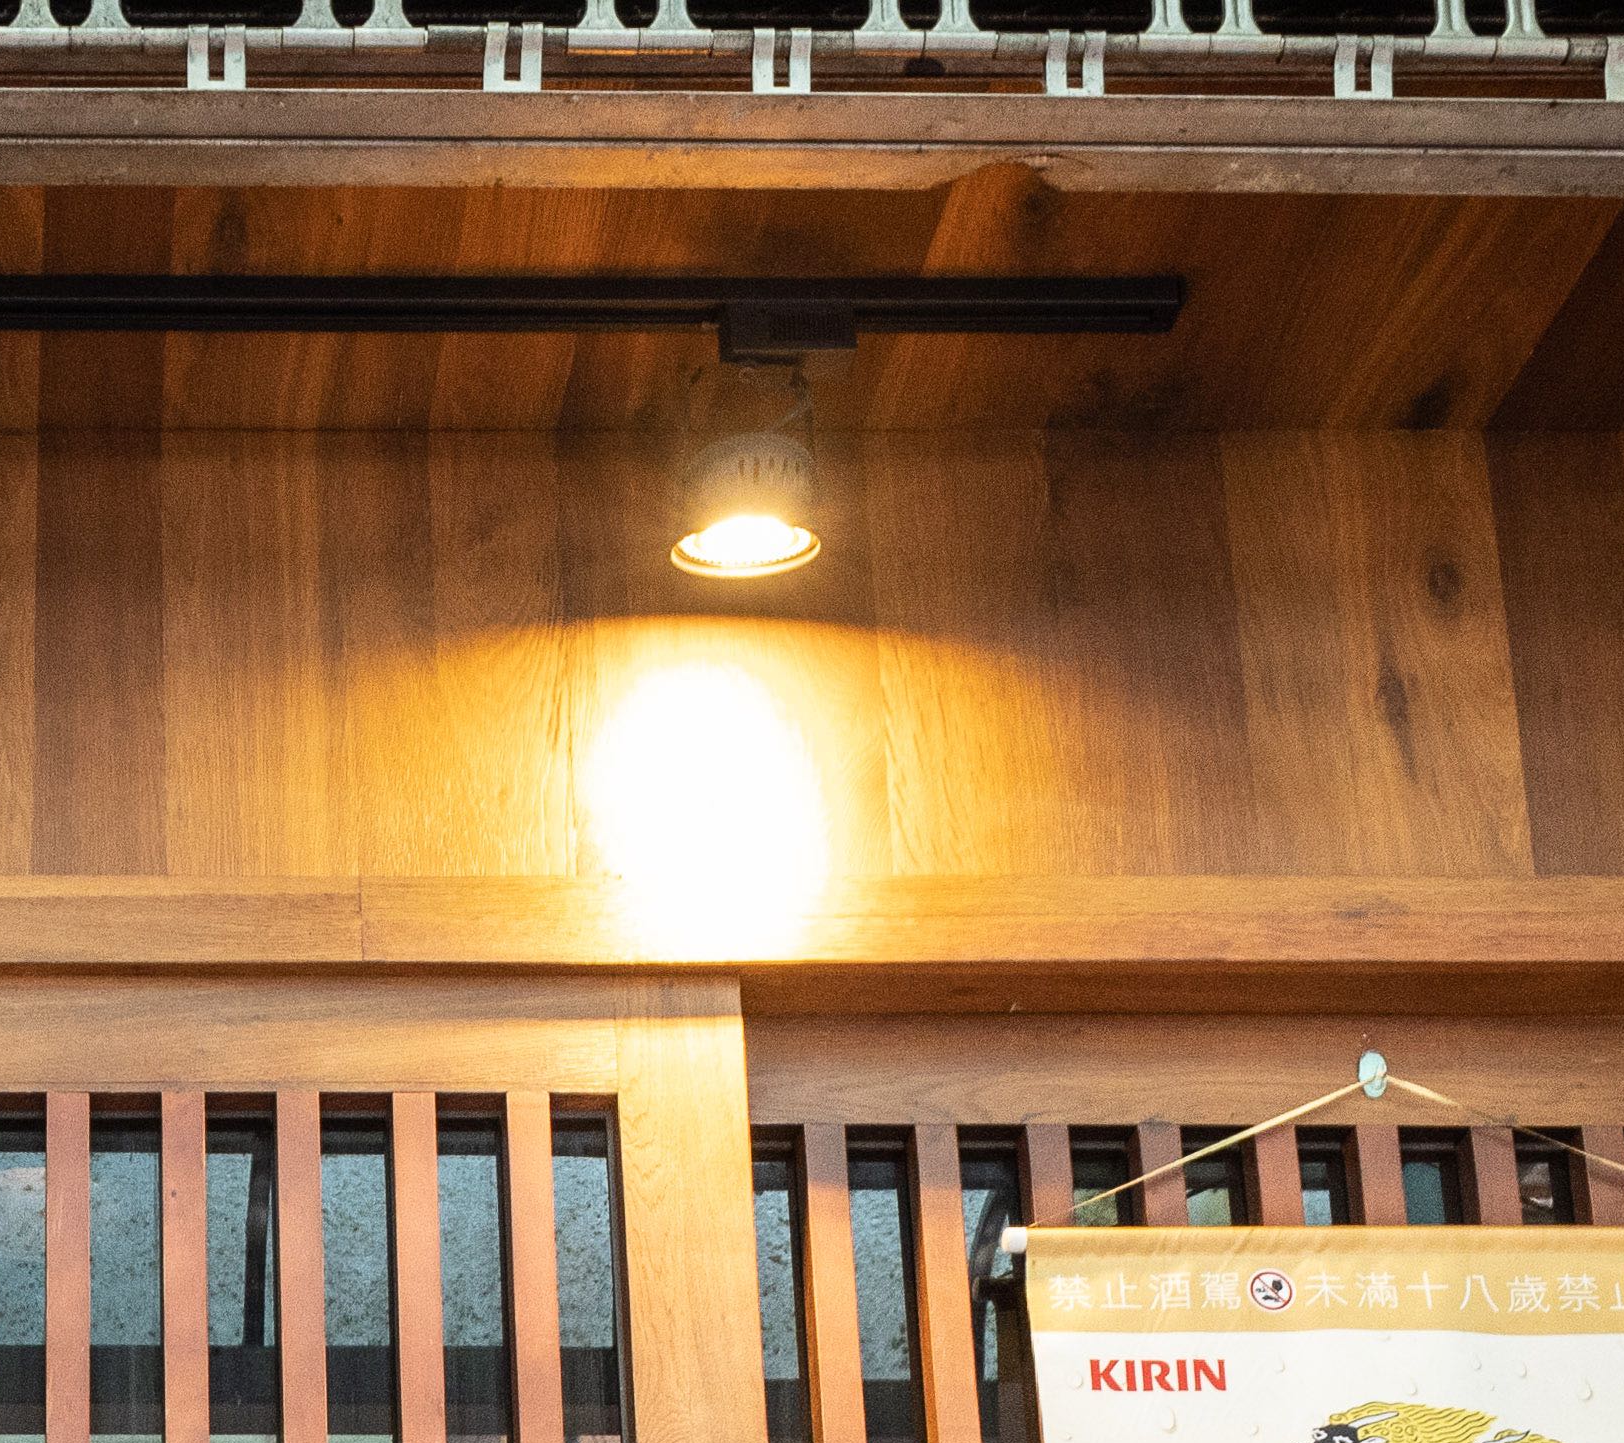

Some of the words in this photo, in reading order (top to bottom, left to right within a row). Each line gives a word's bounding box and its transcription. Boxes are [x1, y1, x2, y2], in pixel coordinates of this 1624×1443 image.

[1049, 1272, 1242, 1312] 禁止酒駕
[1089, 1357, 1227, 1392] KIRIN
